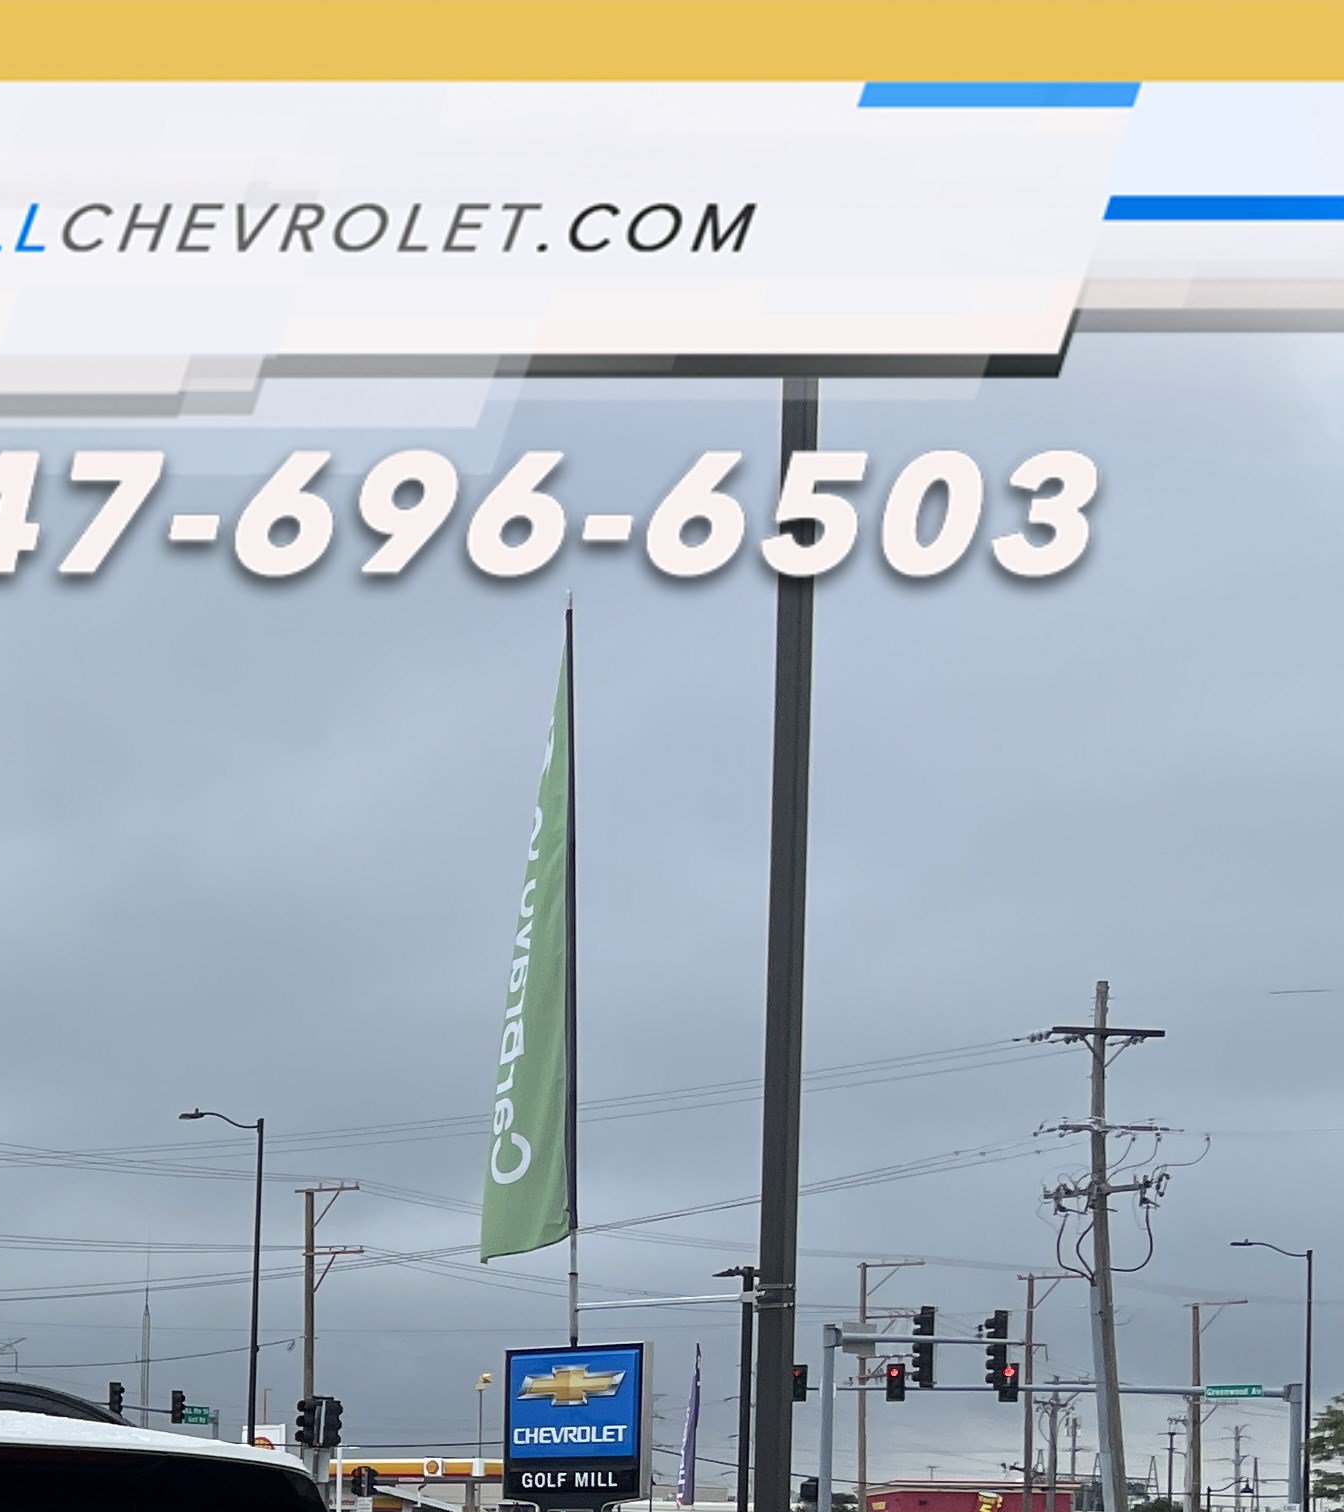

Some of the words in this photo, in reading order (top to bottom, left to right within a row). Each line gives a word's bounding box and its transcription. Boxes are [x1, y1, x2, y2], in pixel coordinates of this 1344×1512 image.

[513, 1424, 627, 1445] CHEVROLET
[521, 1472, 567, 1488] GOLF
[574, 1471, 618, 1488] MILL
